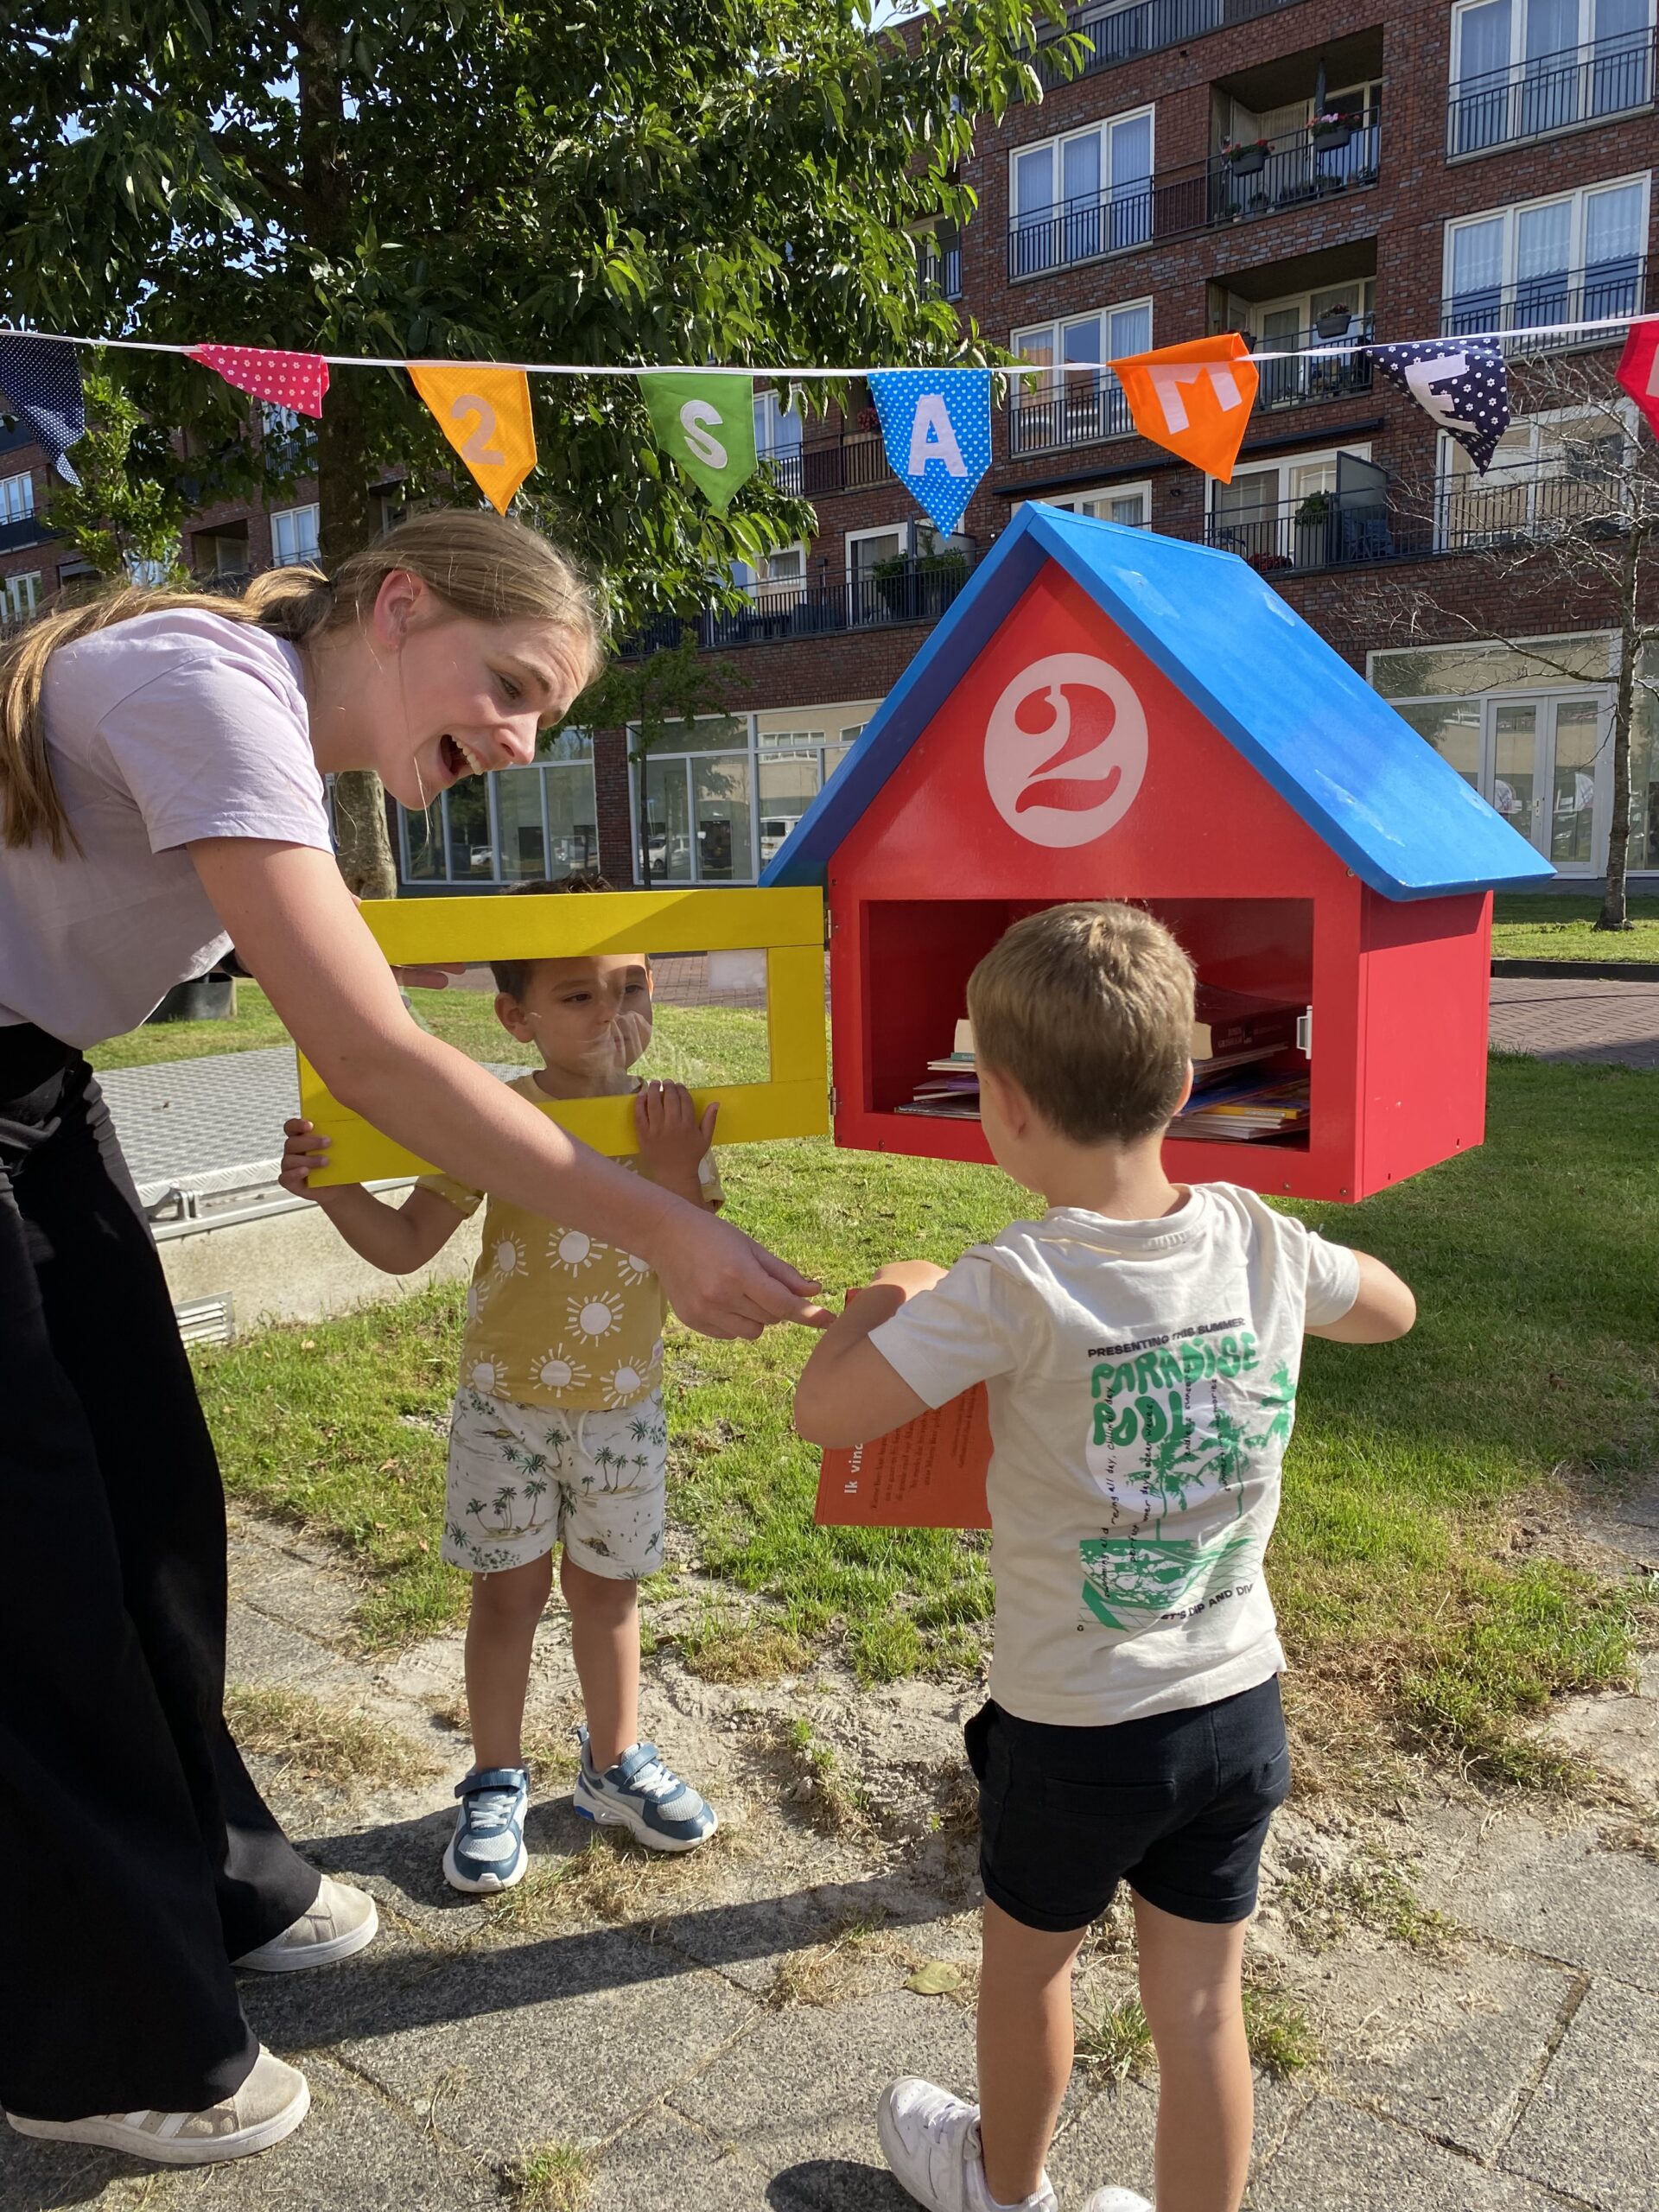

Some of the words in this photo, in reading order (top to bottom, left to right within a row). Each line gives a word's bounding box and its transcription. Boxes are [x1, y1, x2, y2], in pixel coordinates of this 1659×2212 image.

[450, 395, 505, 467] 2
[679, 399, 728, 469] S
[907, 394, 968, 477] A
[1014, 683, 1122, 813] 2
[1088, 1335, 1169, 1358] PRESENTING
[1172, 1326, 1196, 1341] THIS
[1198, 1317, 1246, 1335] SUMMER
[1103, 1387, 1115, 1405] day
[1093, 1390, 1194, 1446] POOL
[1106, 1478, 1115, 1492] all
[1161, 1611, 1186, 1621] ET'S
[1209, 1589, 1233, 1608] AND
